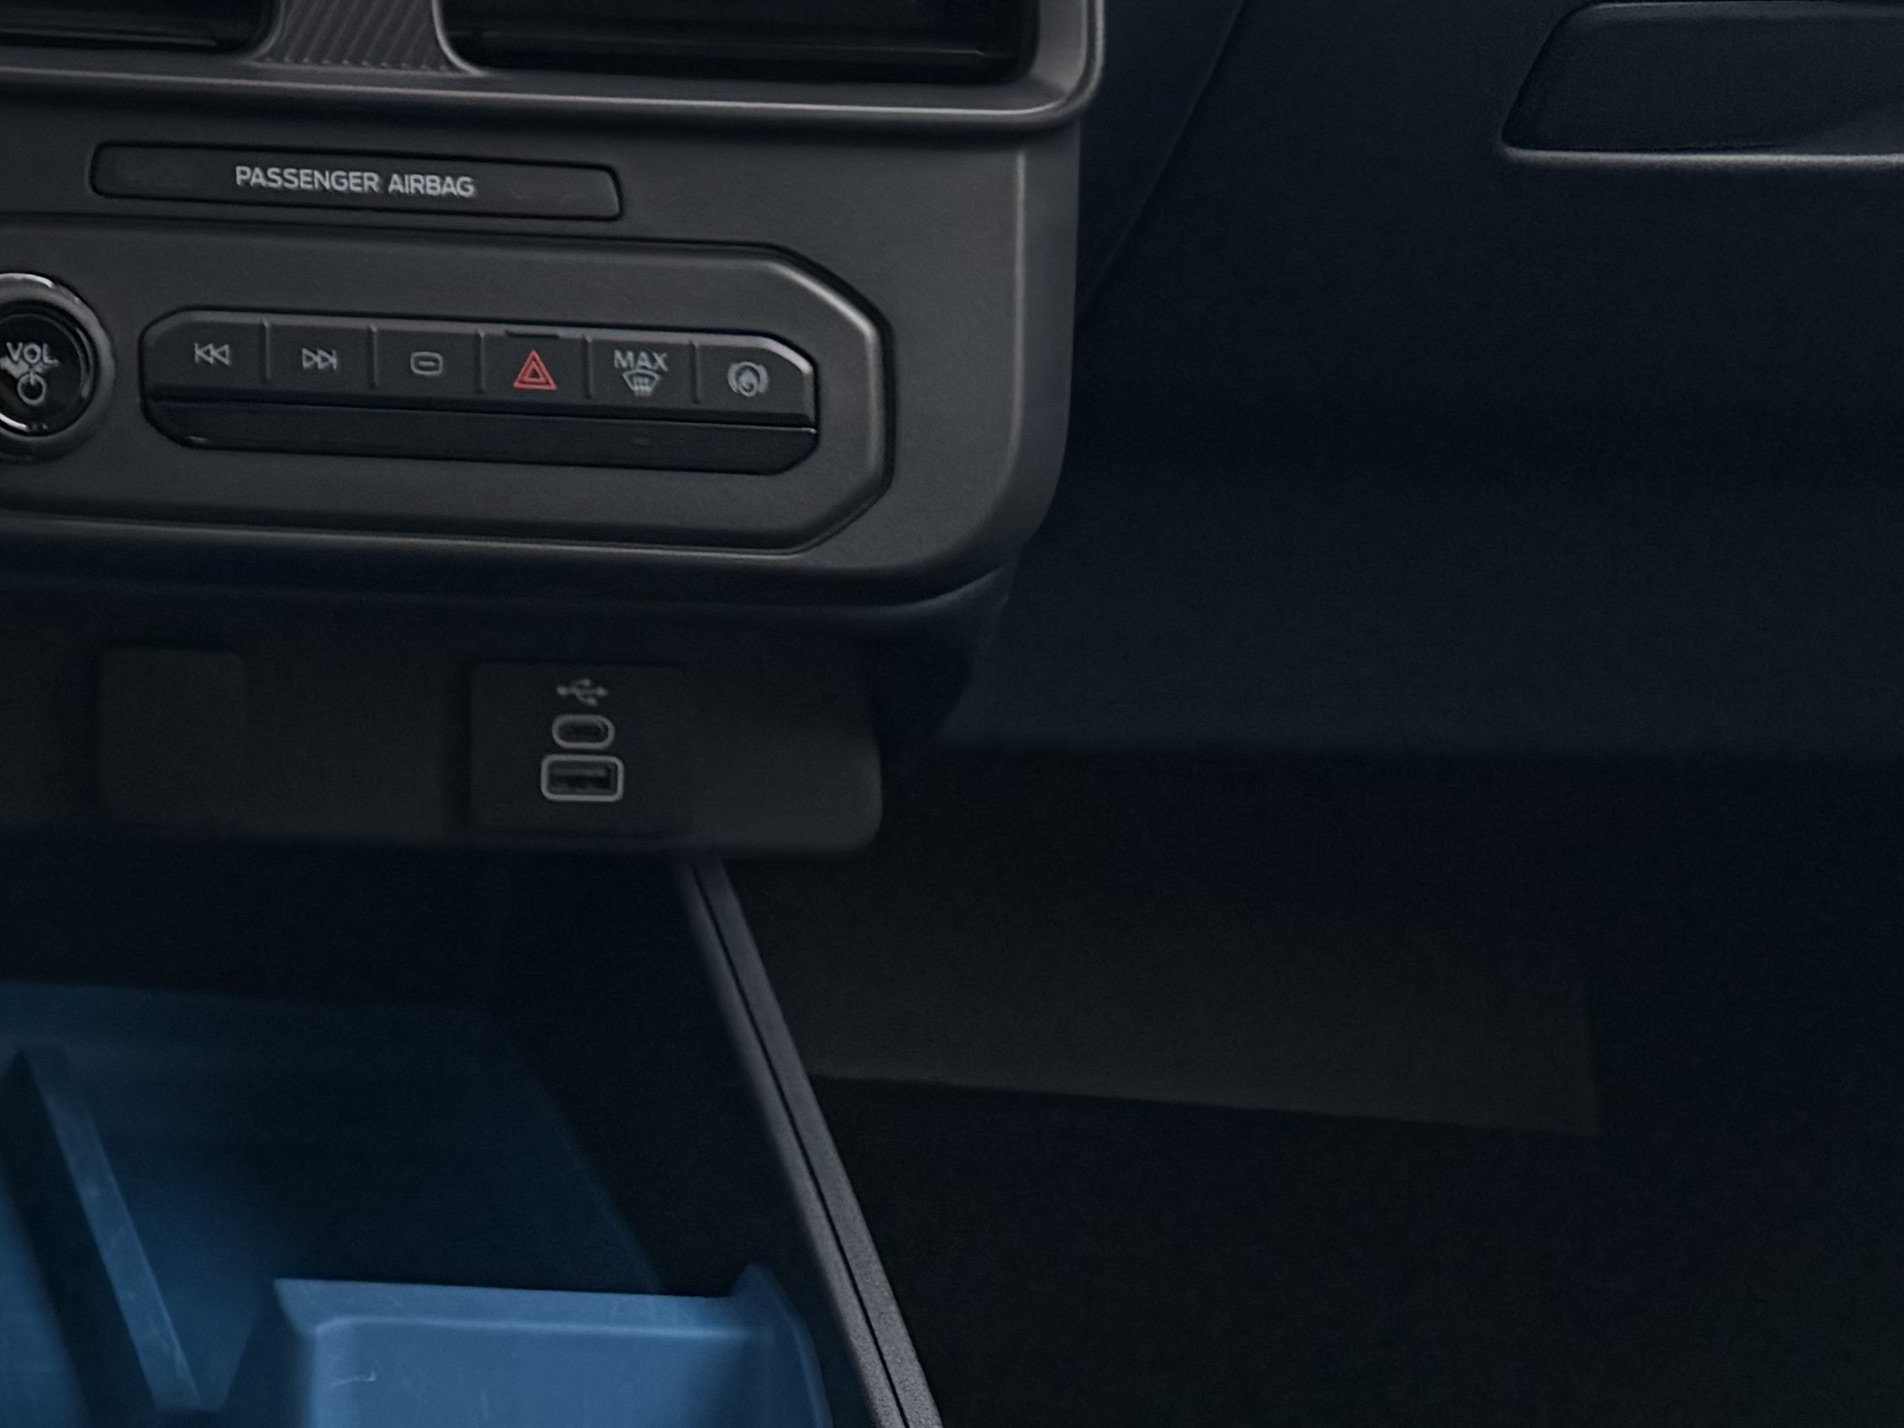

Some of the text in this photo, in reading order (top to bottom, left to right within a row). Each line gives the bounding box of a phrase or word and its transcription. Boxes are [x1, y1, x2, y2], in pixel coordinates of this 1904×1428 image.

[235, 165, 476, 198] PASSENGER AIRBAG
[6, 341, 60, 365] VOL
[613, 349, 669, 372] MAX
